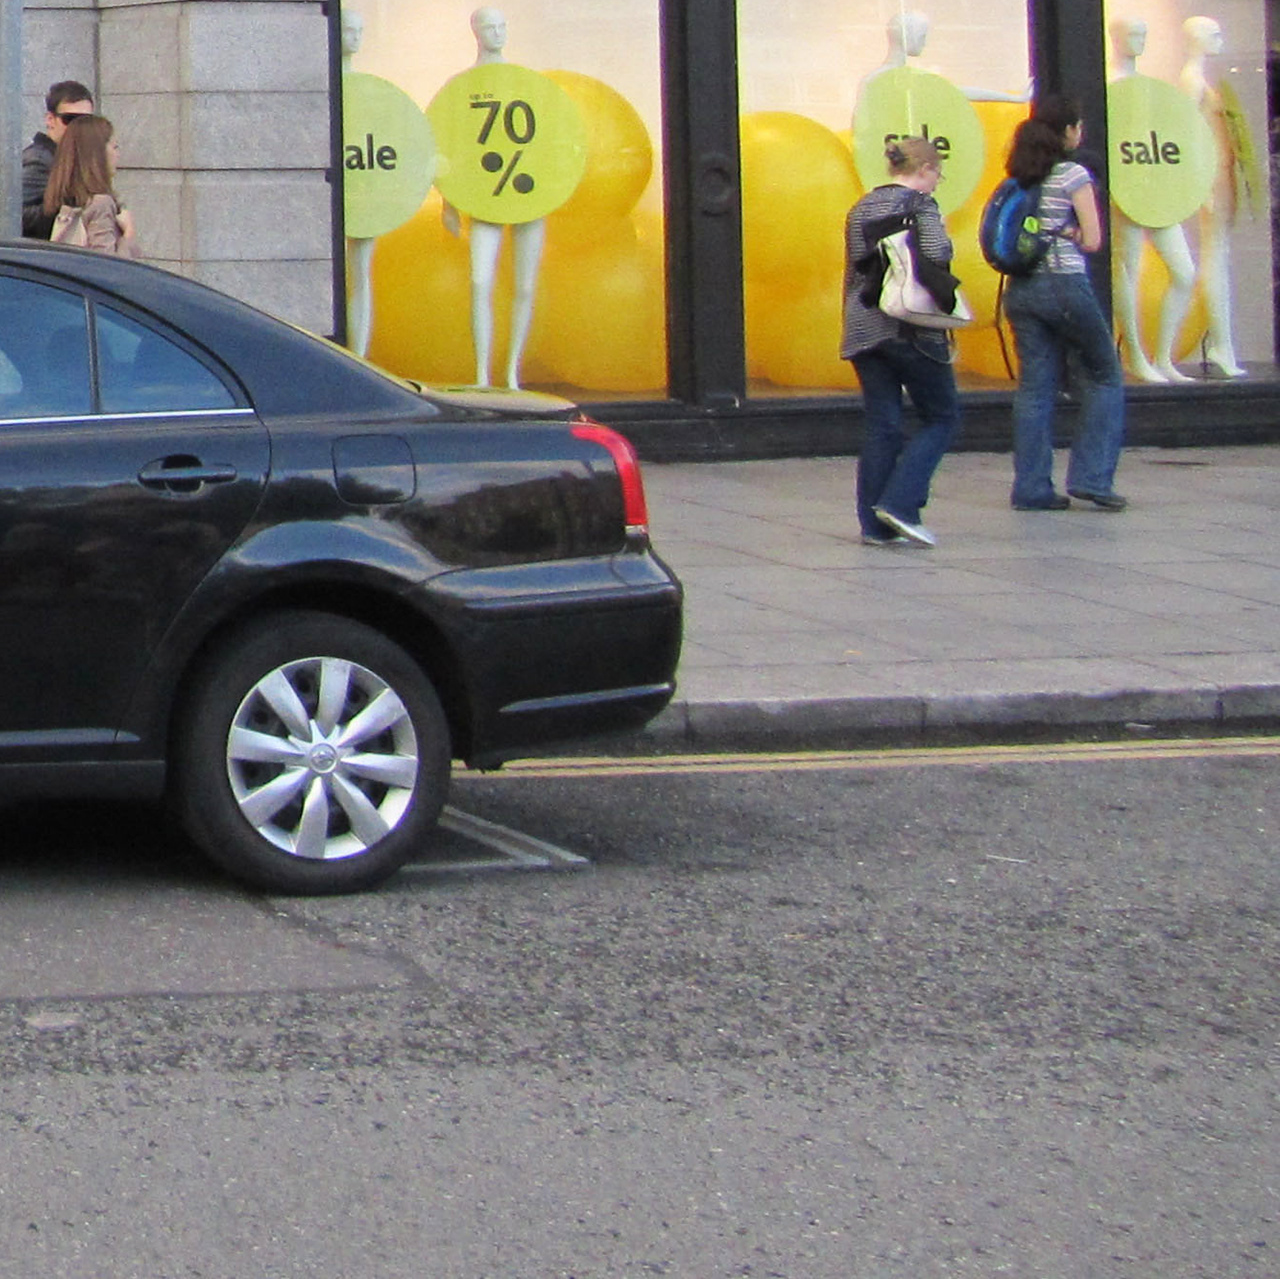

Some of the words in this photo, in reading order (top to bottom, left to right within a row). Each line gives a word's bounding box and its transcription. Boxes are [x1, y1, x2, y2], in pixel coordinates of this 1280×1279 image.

[469, 99, 536, 146] 70
[345, 133, 397, 171] ale
[1119, 130, 1181, 166] sale
[481, 149, 535, 197] %
